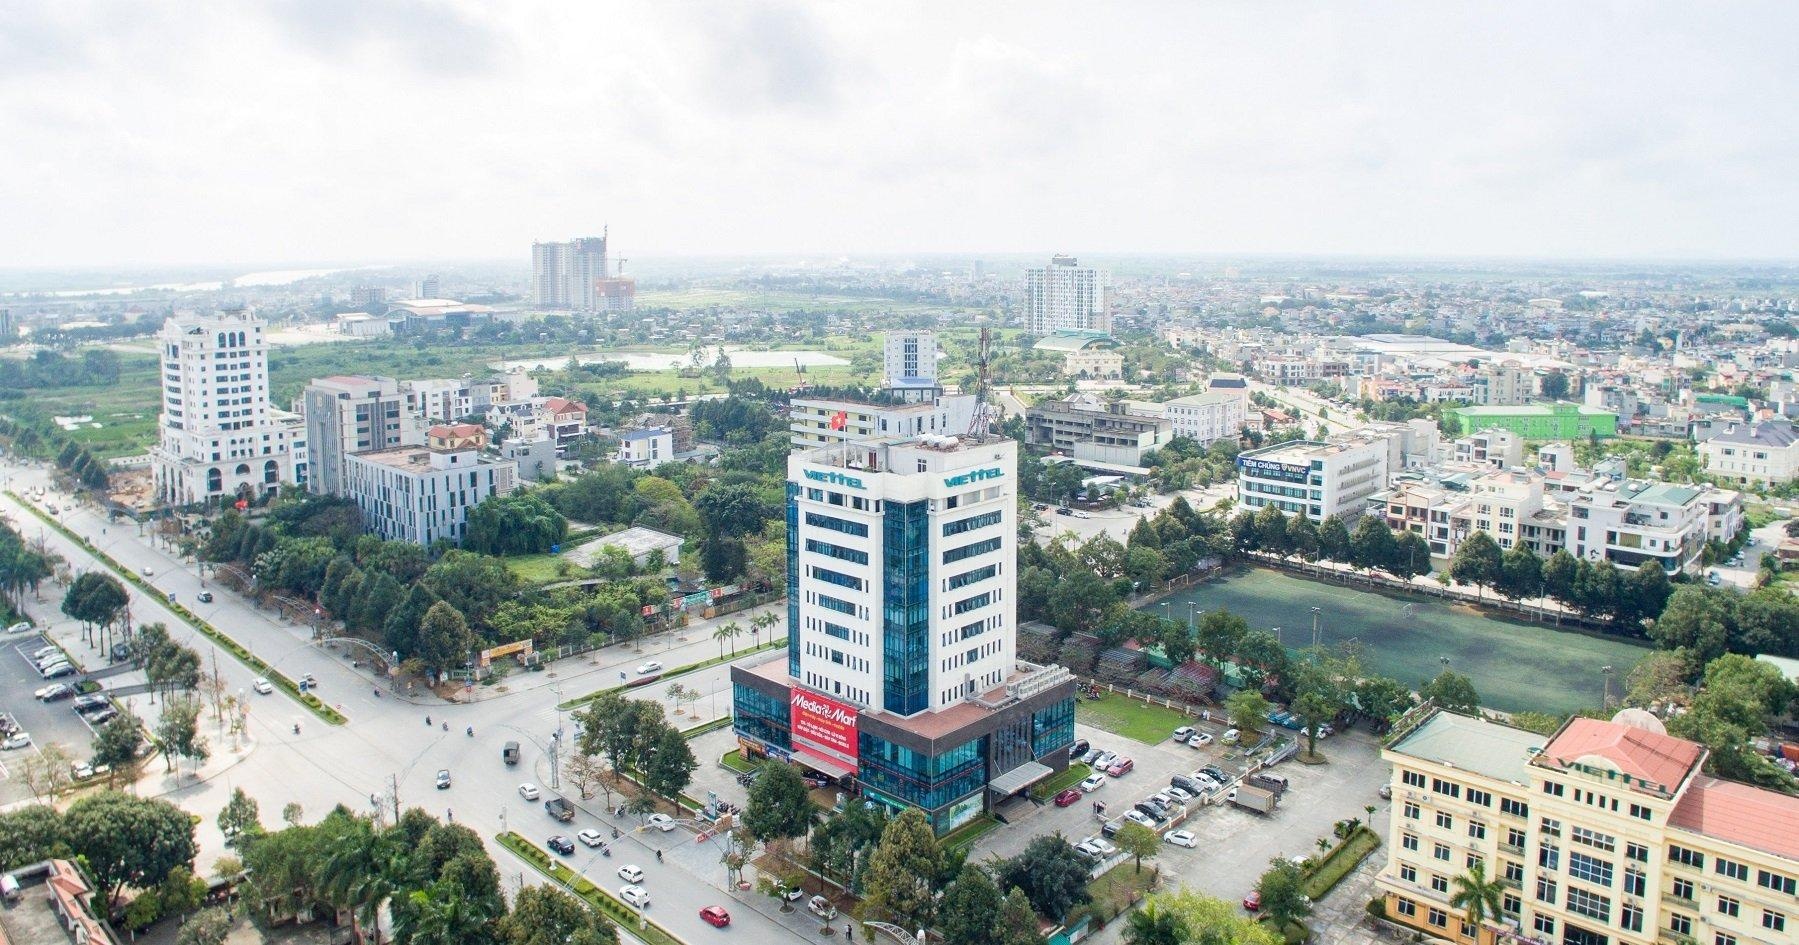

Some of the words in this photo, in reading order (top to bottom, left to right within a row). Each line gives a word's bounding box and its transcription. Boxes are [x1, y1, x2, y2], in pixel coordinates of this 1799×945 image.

[803, 468, 867, 490] VIETTEL
[944, 467, 1005, 488] VIETTEL
[1287, 464, 1306, 474] VNVC
[791, 694, 822, 715] Media
[831, 708, 858, 727] Mart
